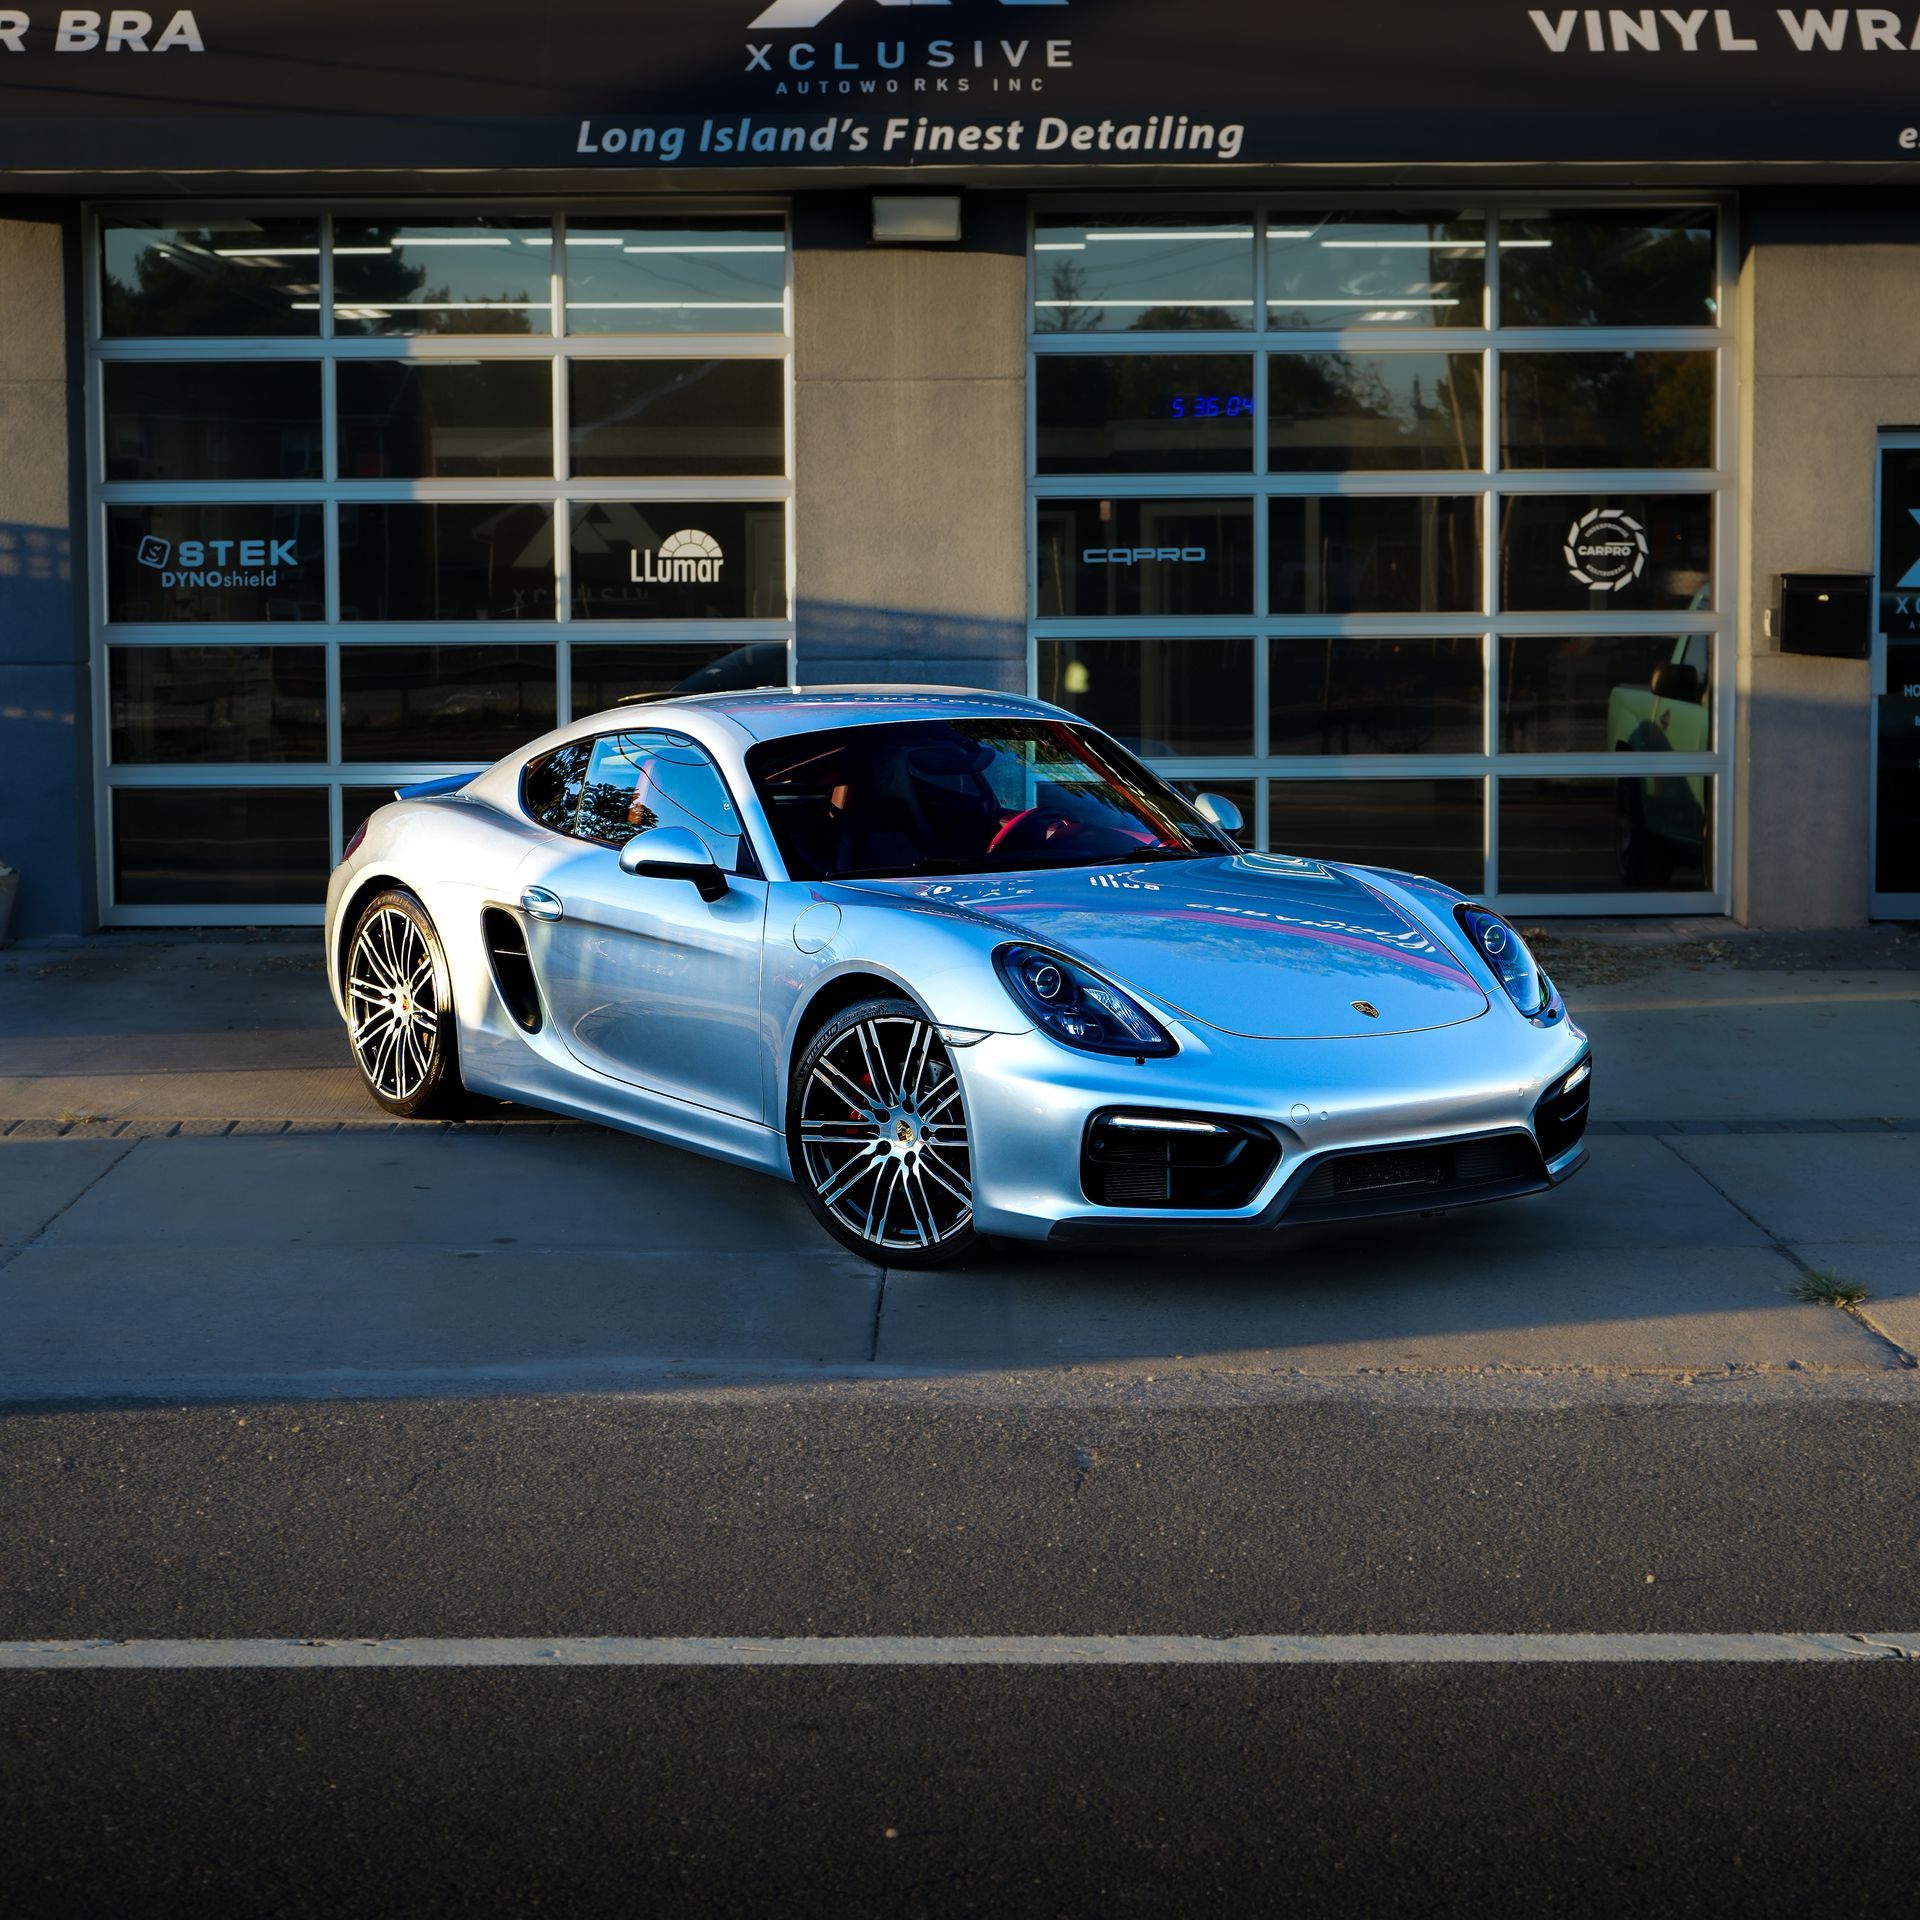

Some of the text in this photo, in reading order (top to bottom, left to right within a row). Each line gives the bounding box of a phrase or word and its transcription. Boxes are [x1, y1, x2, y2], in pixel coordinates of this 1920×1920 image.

[55, 10, 205, 52] BRA
[1527, 9, 1920, 52] VINYL WR
[744, 39, 1073, 72] XCLUSIVE
[775, 77, 1044, 95] AUTOWORKS INC
[576, 115, 1245, 161] Long Island's Finest Detailing
[178, 539, 299, 568] STEK
[630, 548, 725, 584] LLumar
[1577, 545, 1632, 557] CARPRO
[160, 569, 278, 589] DYNOshield
